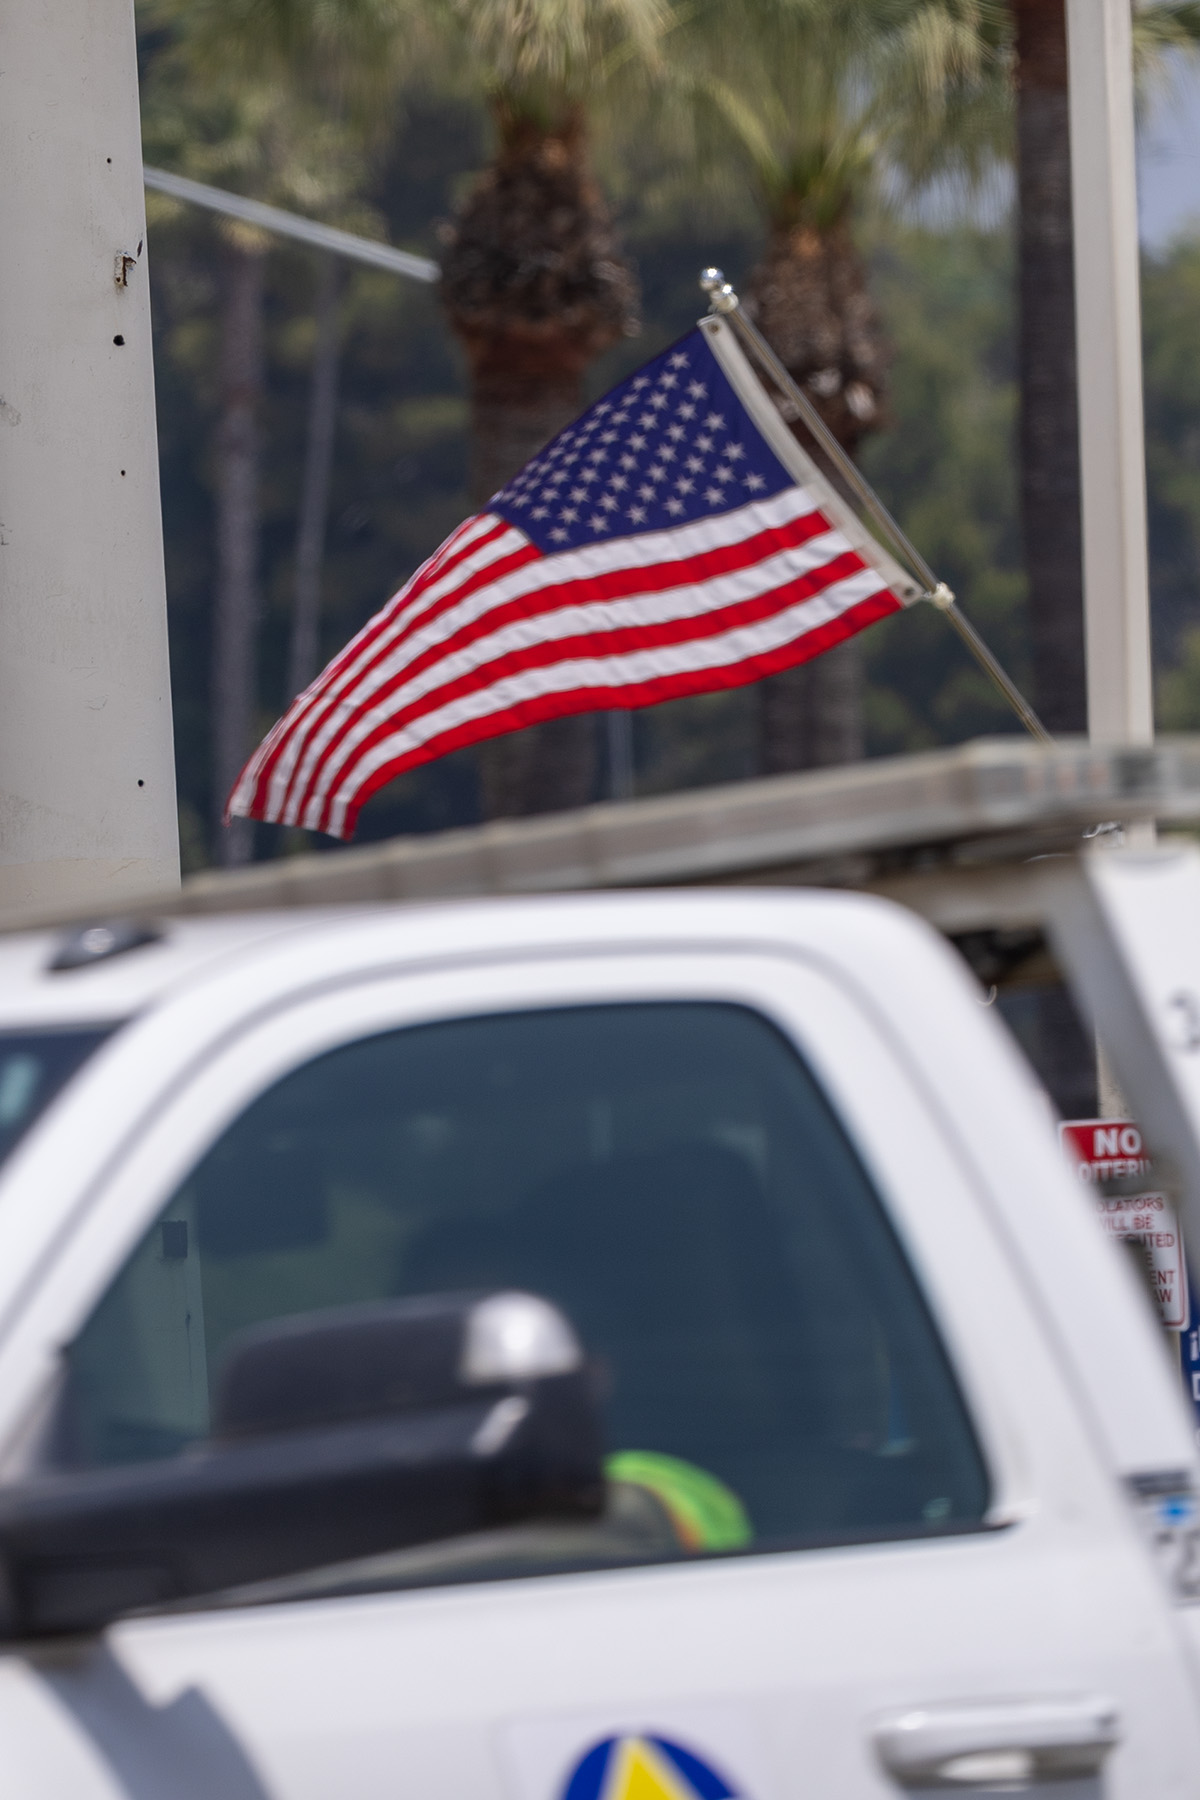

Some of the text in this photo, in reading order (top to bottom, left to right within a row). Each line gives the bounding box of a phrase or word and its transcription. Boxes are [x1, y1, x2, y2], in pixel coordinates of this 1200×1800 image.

[1094, 1128, 1142, 1156] NO
[1078, 1159, 1152, 1183] OITERI
[1096, 1196, 1164, 1214] OLATORS
[1101, 1214, 1154, 1231] ILL BE
